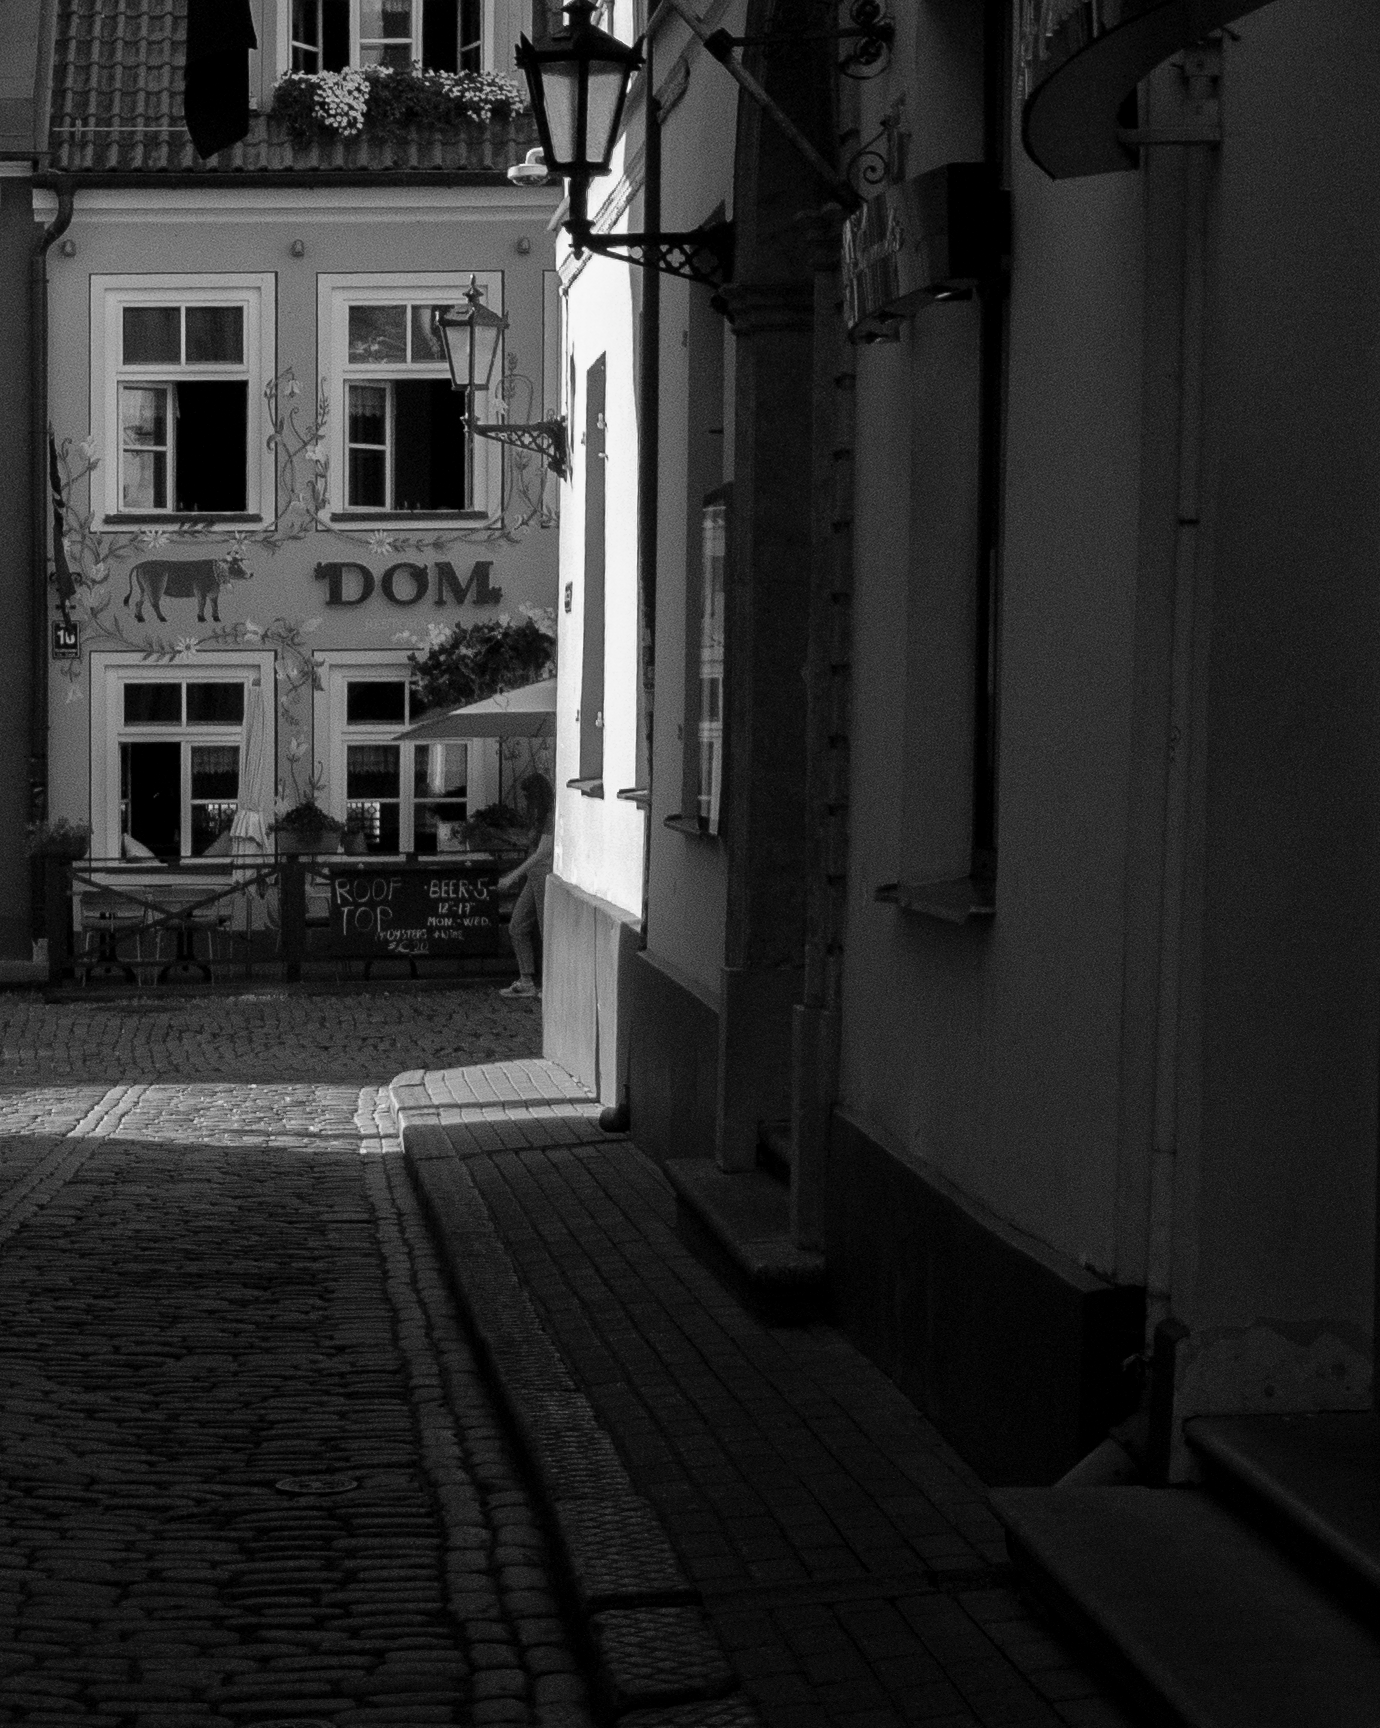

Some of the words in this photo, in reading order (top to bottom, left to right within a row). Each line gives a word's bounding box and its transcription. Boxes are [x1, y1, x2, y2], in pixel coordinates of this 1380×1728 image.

[314, 560, 503, 605] DOM
[334, 876, 402, 905] ROOF
[340, 905, 393, 936] TOP
